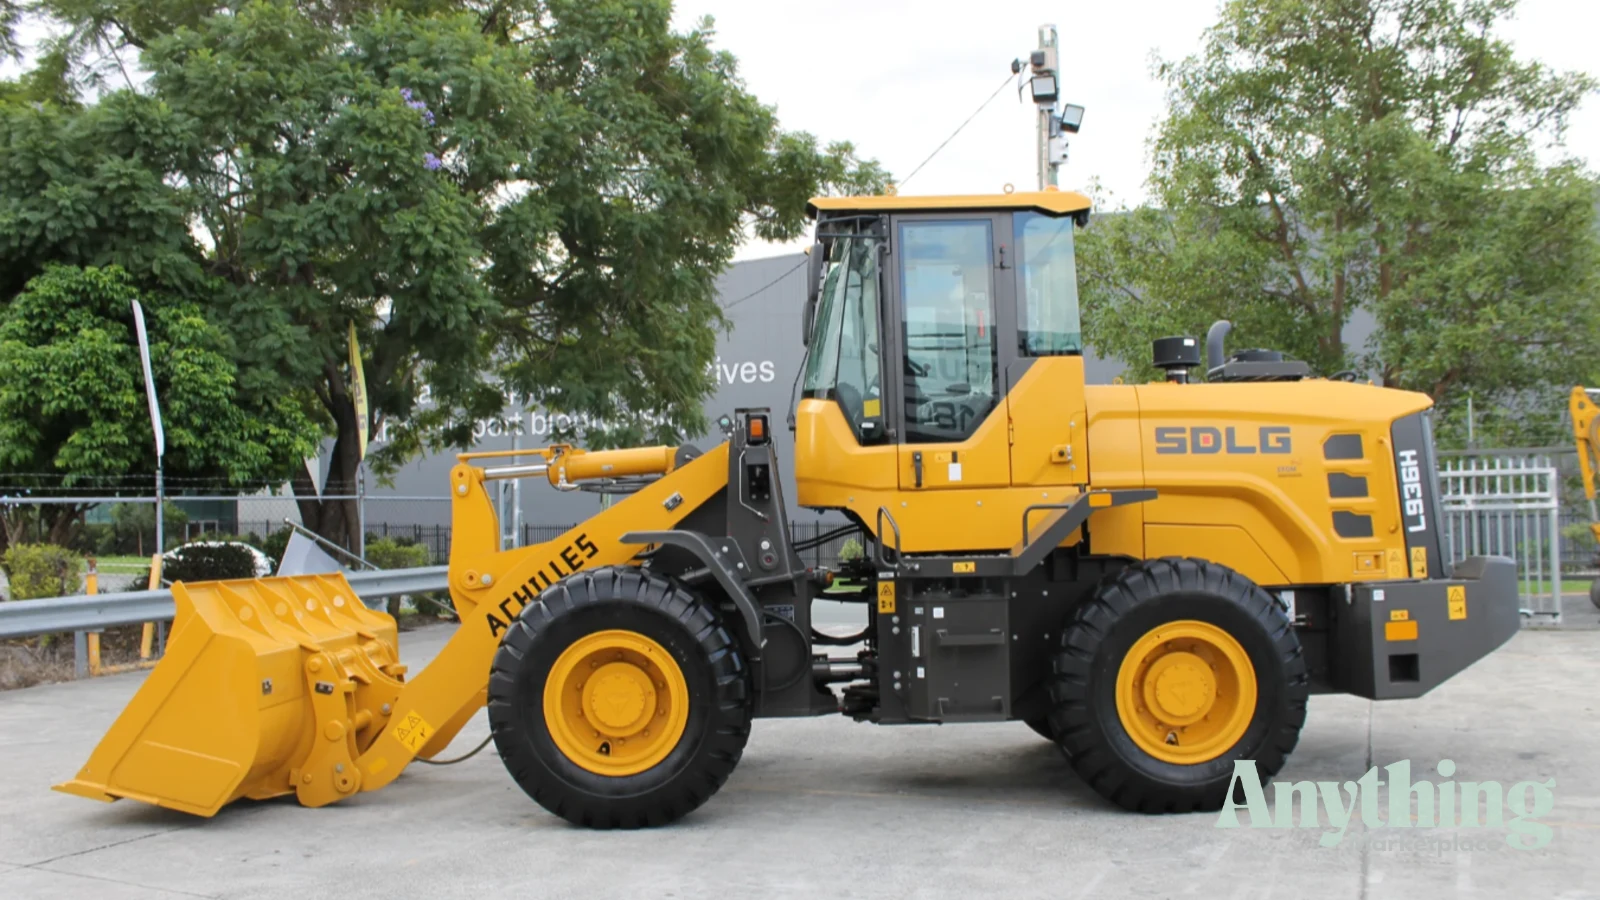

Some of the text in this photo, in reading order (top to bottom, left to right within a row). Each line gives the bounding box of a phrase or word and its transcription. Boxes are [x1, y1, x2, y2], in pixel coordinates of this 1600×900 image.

[1155, 426, 1292, 454] SDLG
[1399, 449, 1427, 532] L936H
[486, 533, 599, 638] ACHILLES
